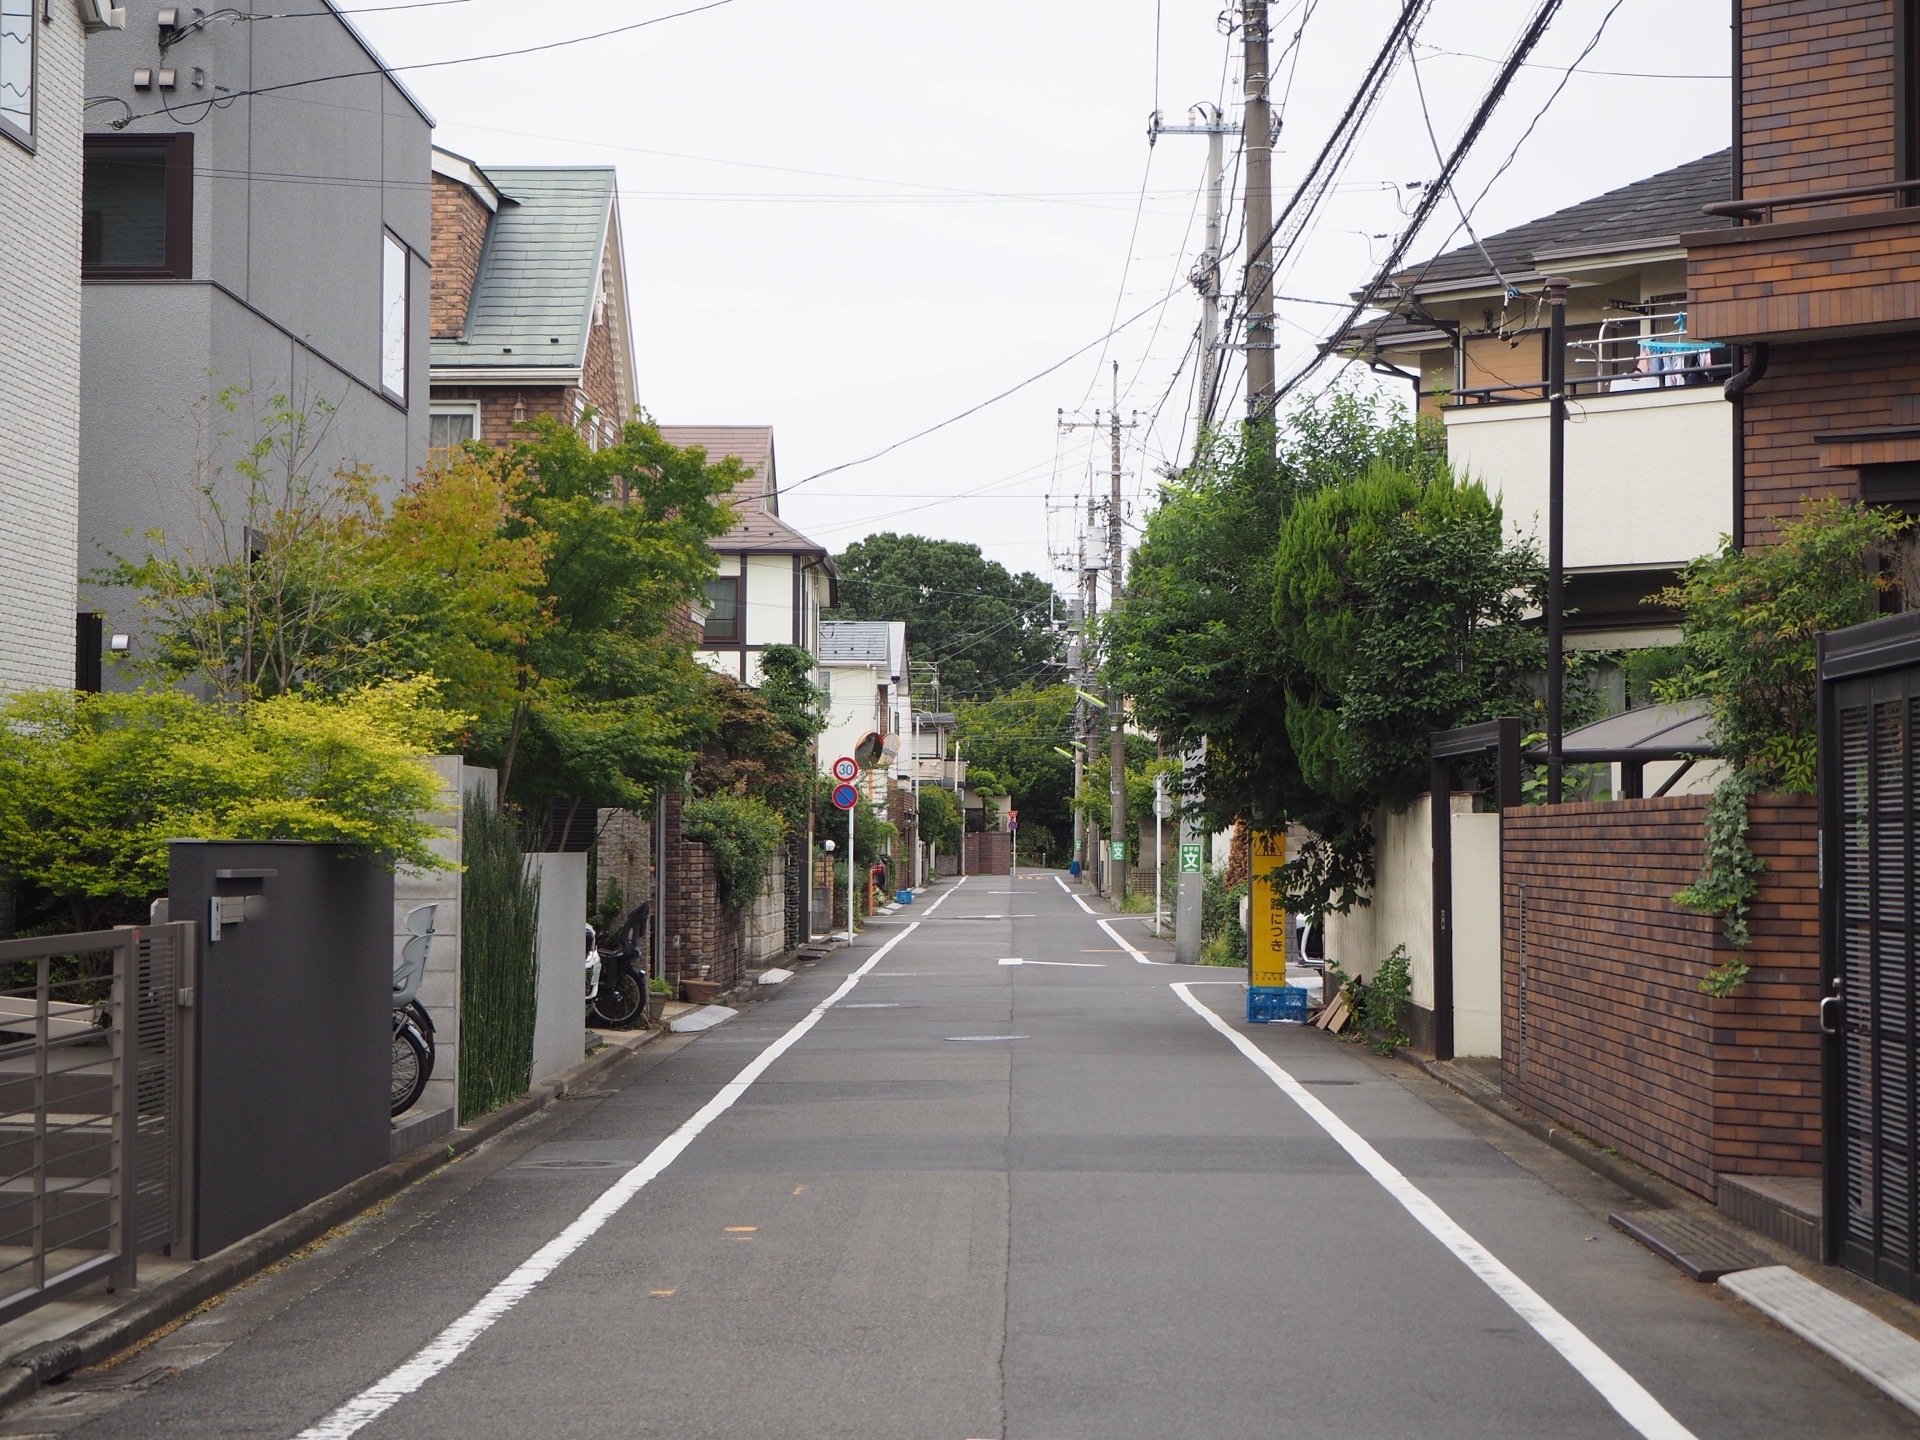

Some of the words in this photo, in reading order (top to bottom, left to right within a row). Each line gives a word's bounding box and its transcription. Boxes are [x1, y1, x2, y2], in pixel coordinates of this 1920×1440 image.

[839, 764, 853, 775] 30
[1113, 846, 1123, 858] 文
[1183, 852, 1198, 868] 文
